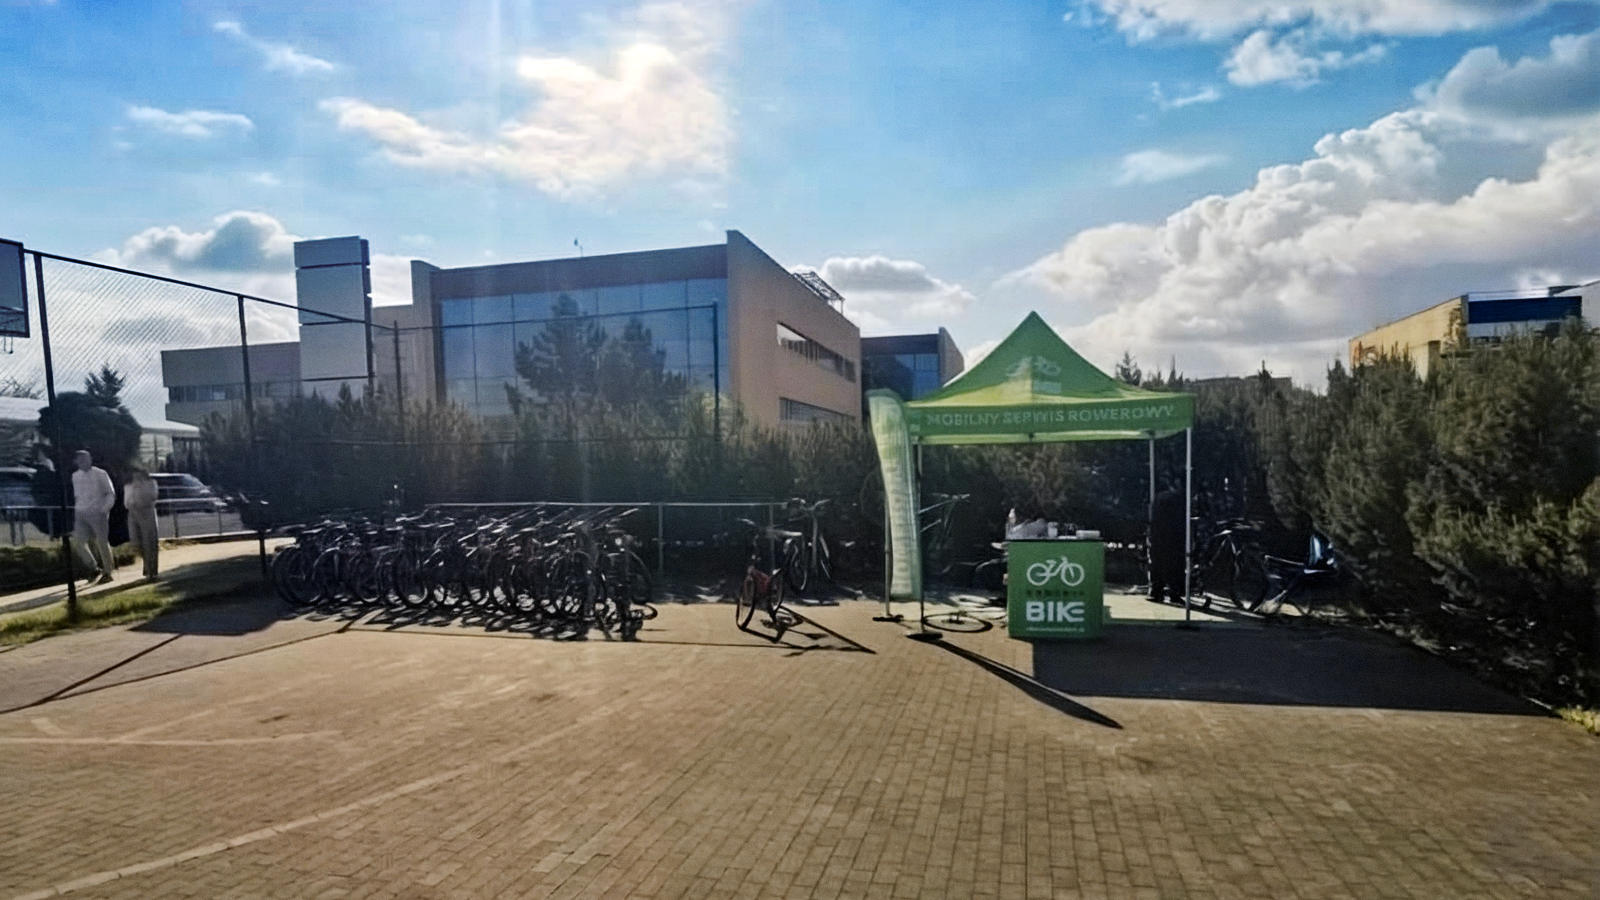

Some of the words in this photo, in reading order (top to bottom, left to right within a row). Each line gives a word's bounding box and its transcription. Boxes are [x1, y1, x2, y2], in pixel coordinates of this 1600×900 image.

[927, 412, 999, 426] MOBILNY
[1003, 408, 1064, 425] SERWIS
[1068, 404, 1174, 422] ROWEROWY
[1026, 601, 1085, 622] BIKE
